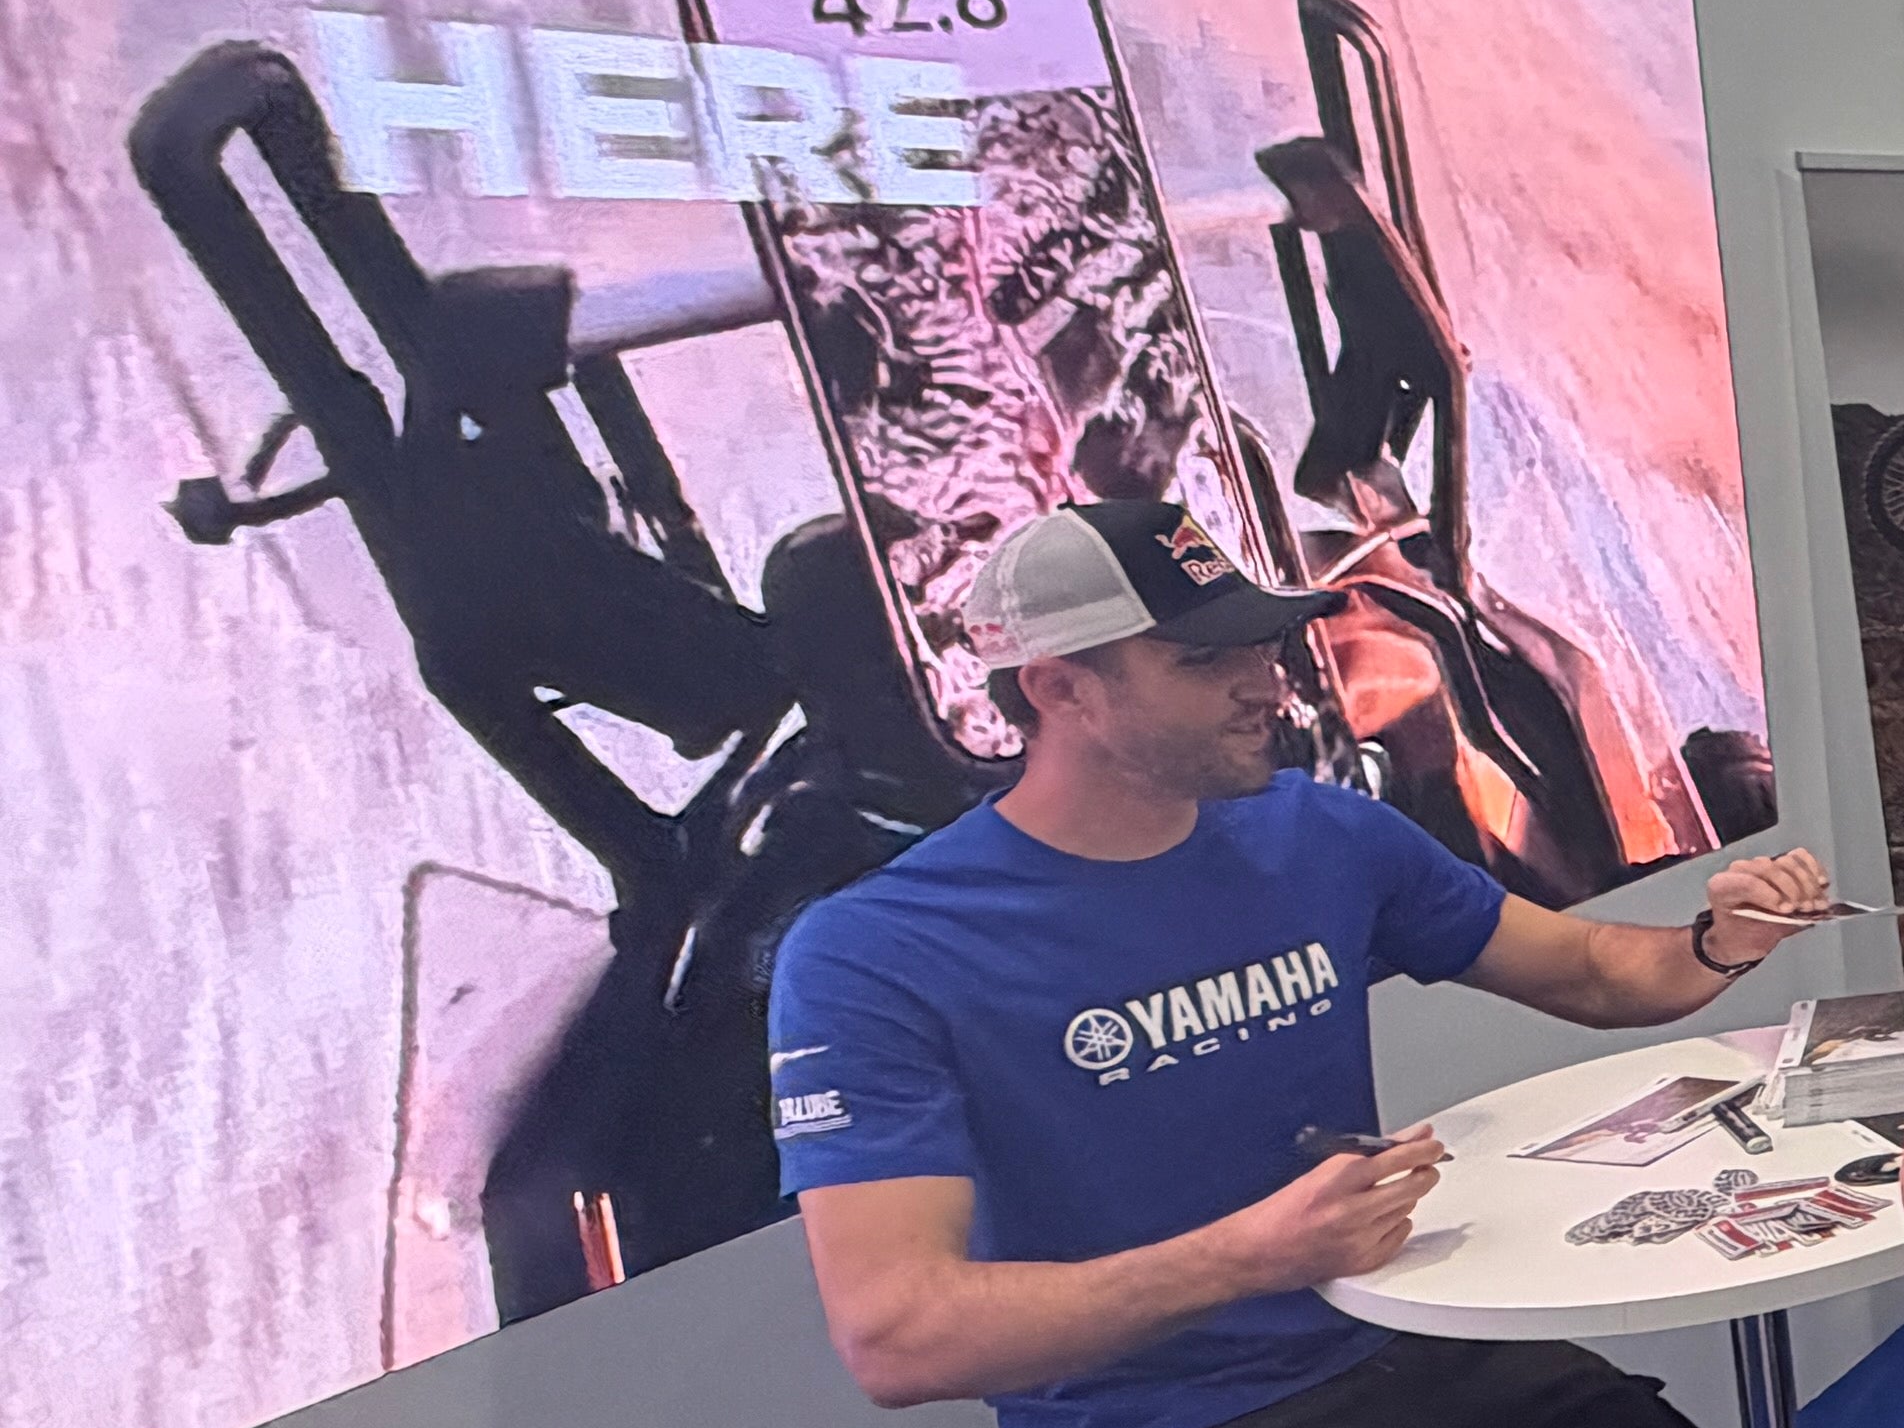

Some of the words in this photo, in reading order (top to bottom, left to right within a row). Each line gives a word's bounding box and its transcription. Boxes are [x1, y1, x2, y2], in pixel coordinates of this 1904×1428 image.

[309, 8, 986, 208] HERE
[1098, 998, 1333, 1087] RACING
[1127, 942, 1340, 1049] YAMAHA
